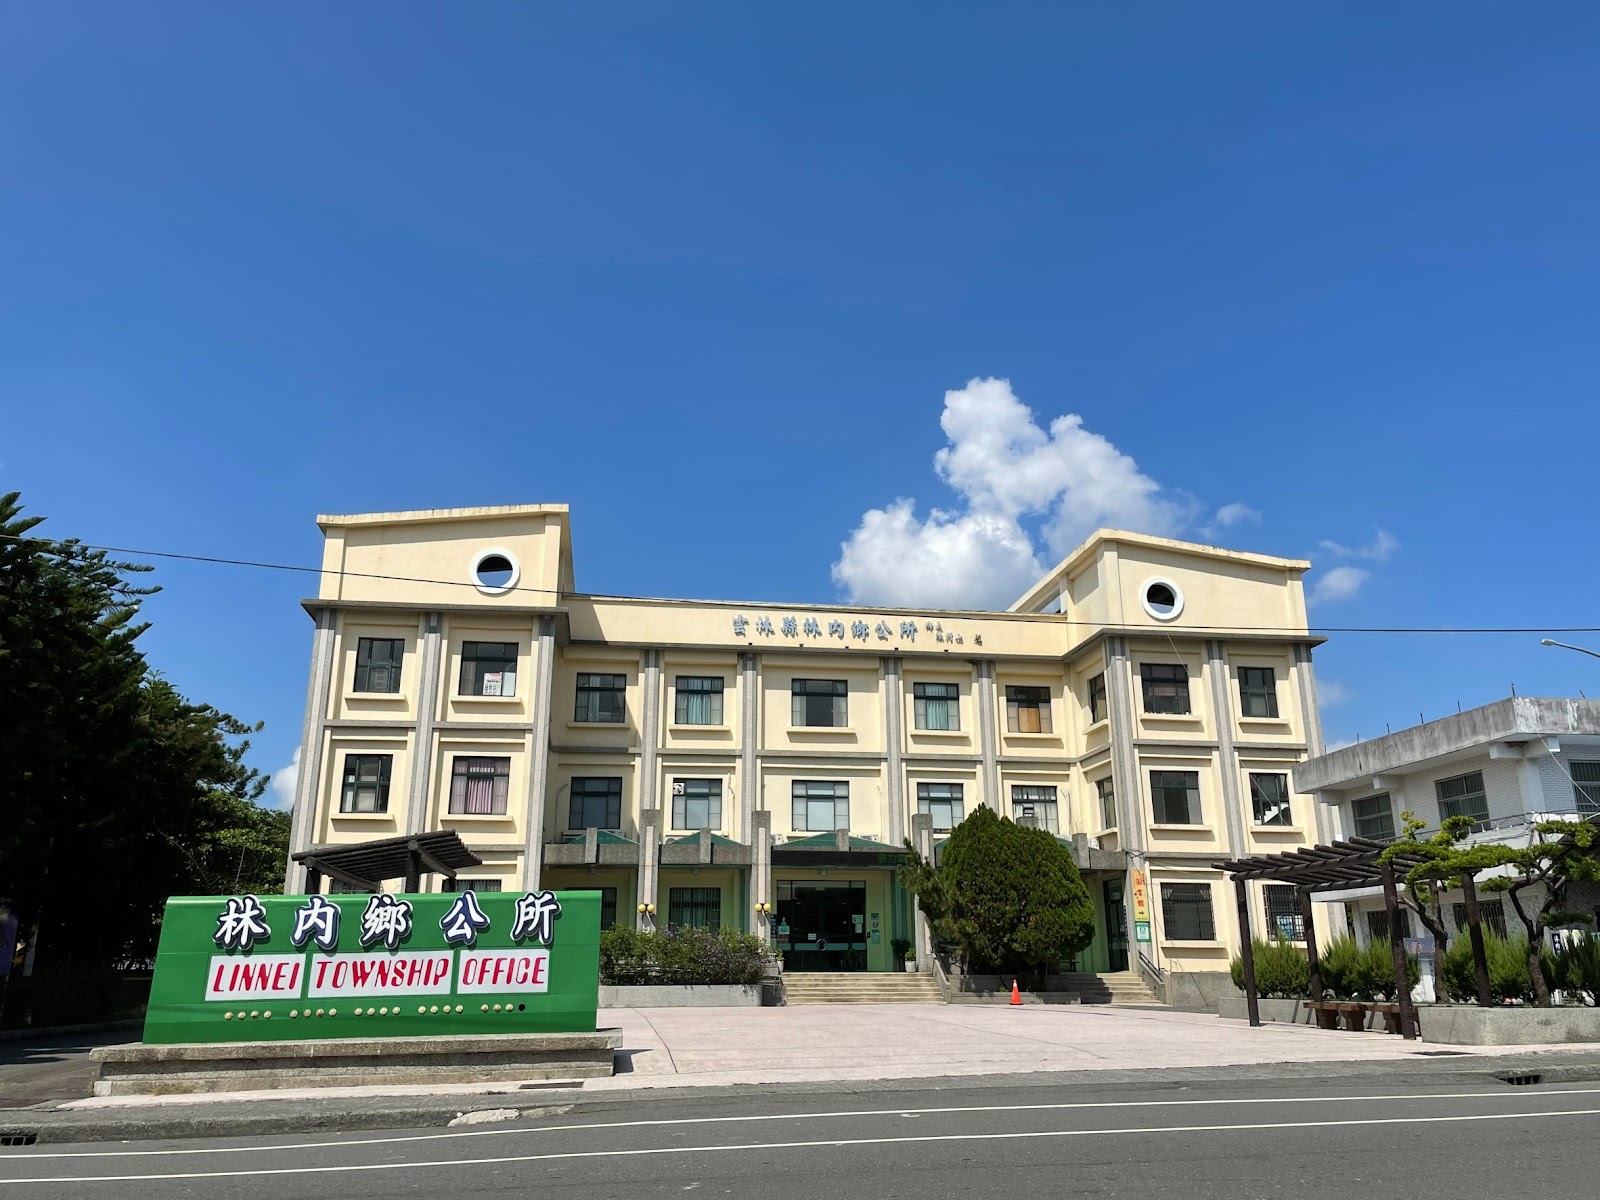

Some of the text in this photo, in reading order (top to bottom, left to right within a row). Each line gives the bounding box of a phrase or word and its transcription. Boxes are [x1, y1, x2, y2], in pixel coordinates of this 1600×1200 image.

[732, 613, 918, 643] 雲林縣林內鄉公所
[213, 889, 562, 950] 林內鄉公所
[213, 956, 546, 993] LINNEI TOWNSHIP OFFICE
